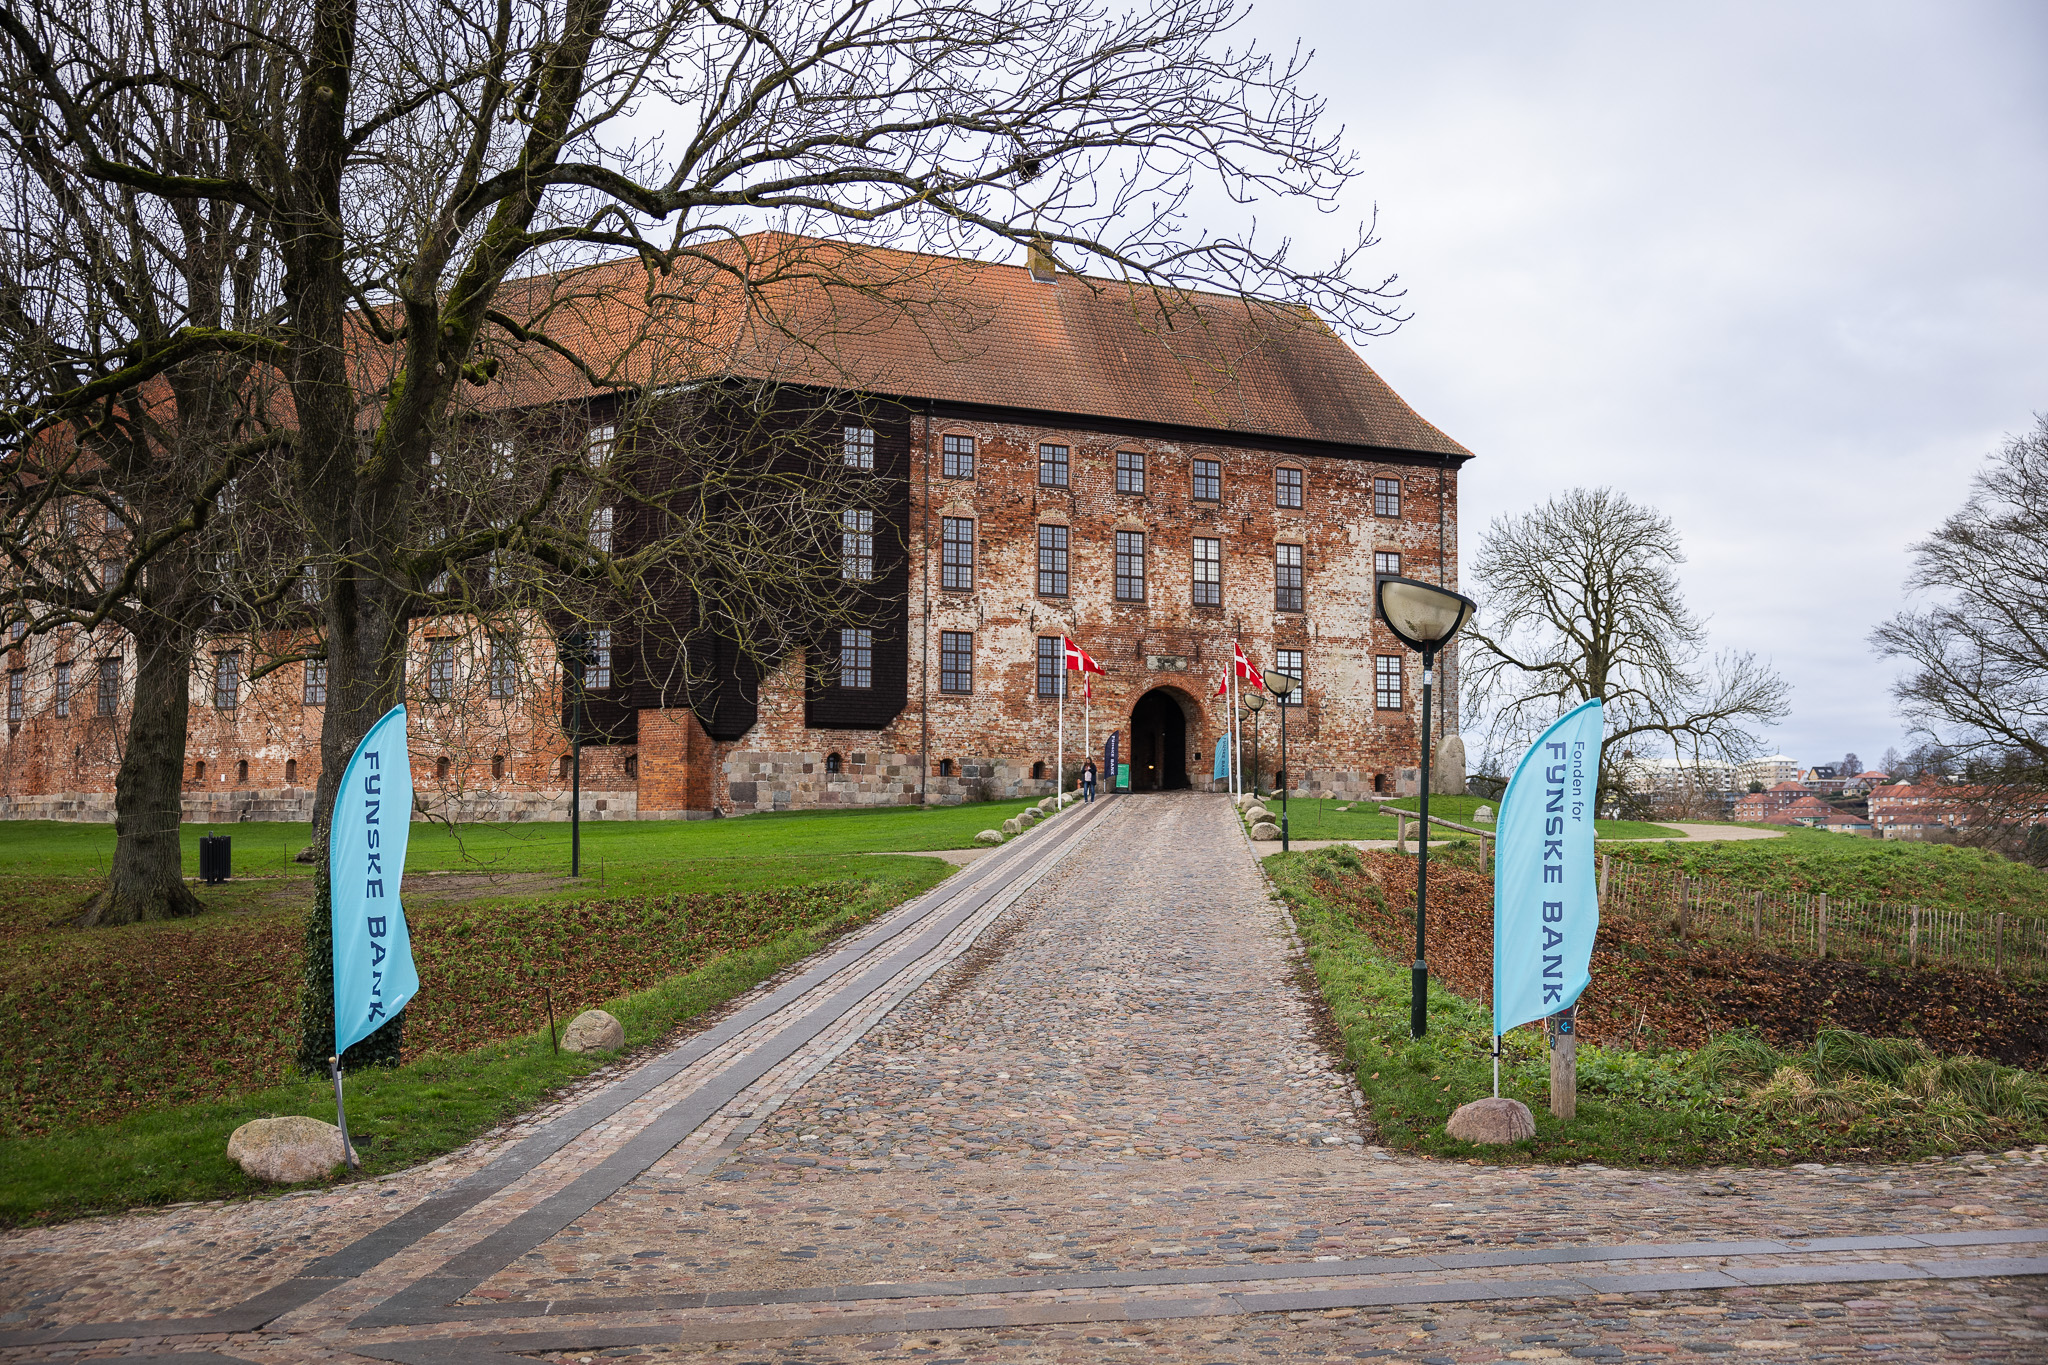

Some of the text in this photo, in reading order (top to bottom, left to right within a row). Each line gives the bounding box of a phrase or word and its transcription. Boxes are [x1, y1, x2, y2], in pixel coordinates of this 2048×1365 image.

[364, 751, 386, 1023] FYNSKE BANK
[1542, 741, 1567, 1005] FYNSKE BANK
[1572, 741, 1585, 822] Fonden for
